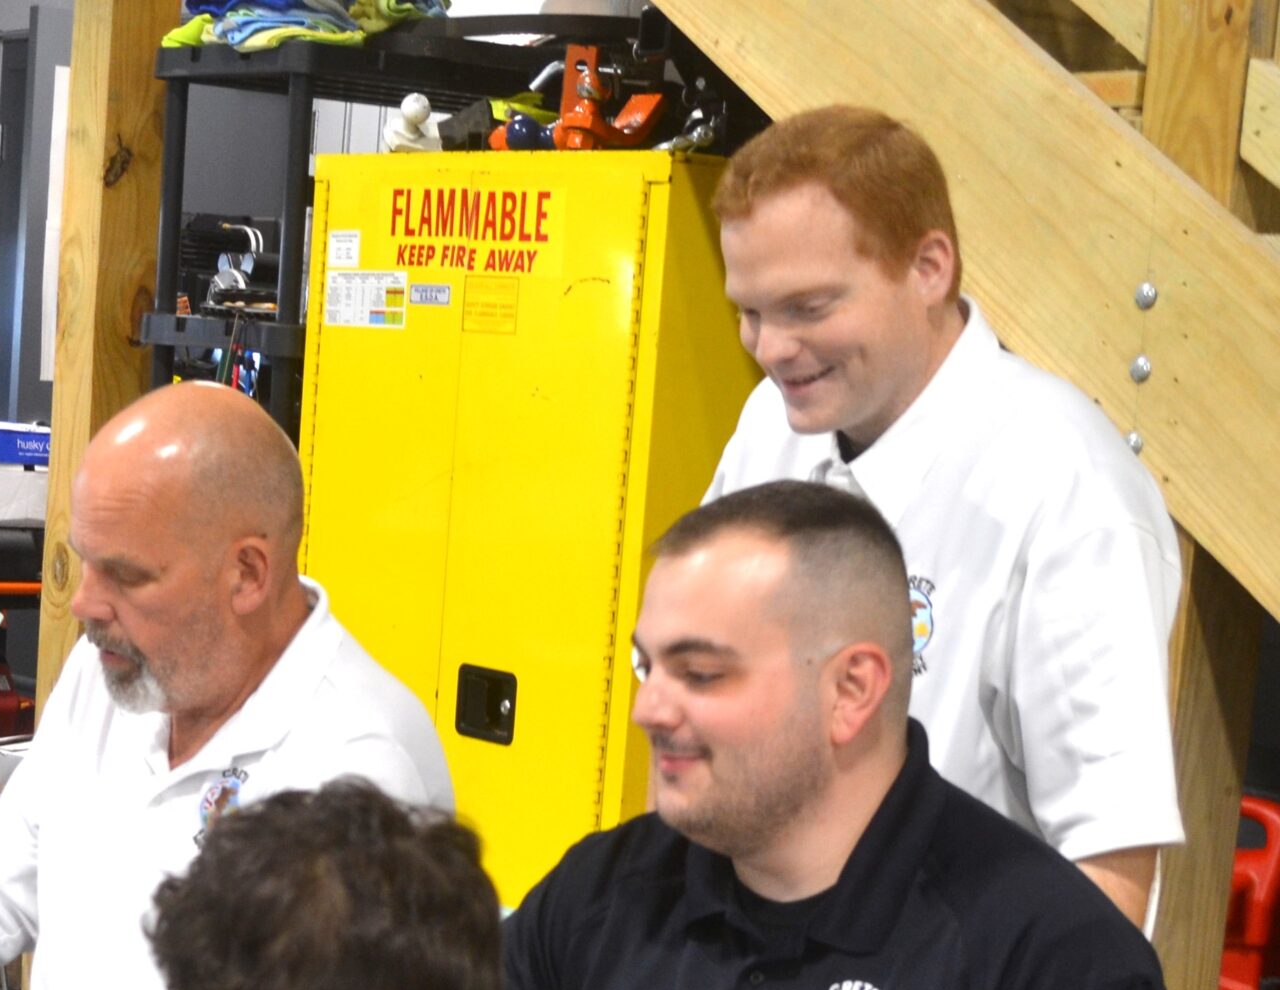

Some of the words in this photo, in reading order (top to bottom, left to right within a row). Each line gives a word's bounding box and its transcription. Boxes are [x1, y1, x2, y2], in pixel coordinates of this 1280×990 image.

[391, 188, 551, 242] FLAMMABLE
[396, 244, 436, 267] KEEP
[440, 245, 477, 271] FIRE
[484, 249, 538, 273] AWAY
[17, 438, 44, 451] husky
